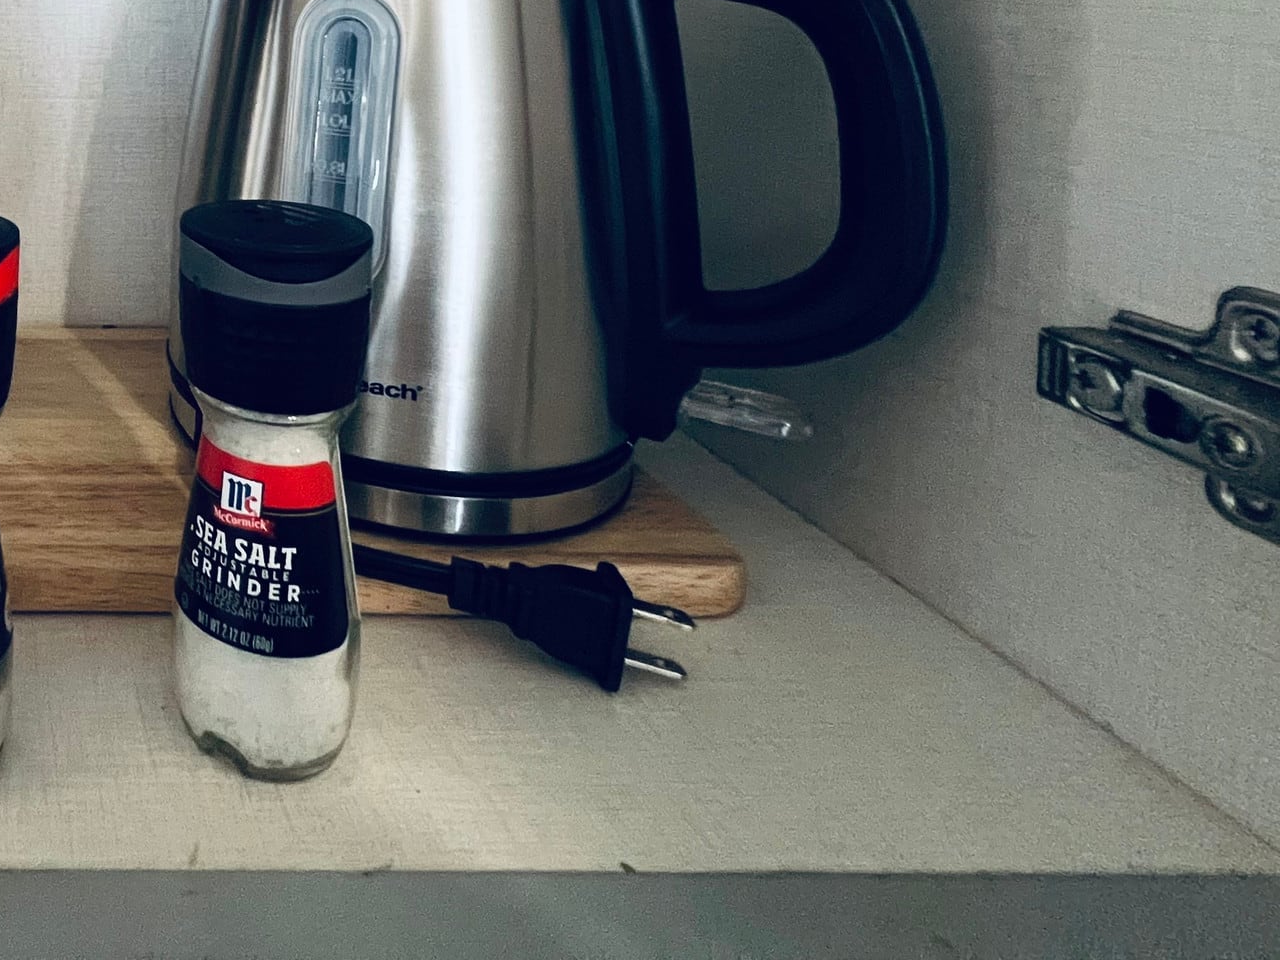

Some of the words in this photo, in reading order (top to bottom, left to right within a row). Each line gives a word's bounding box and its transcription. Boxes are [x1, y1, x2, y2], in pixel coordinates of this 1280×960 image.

[320, 88, 357, 105] MAX
[360, 379, 418, 401] each
[213, 504, 268, 532] McCormick
[195, 514, 228, 556] SEA
[234, 537, 297, 571] SALT
[191, 548, 301, 603] GRINDER
[198, 541, 290, 582] ADJUSTABLE
